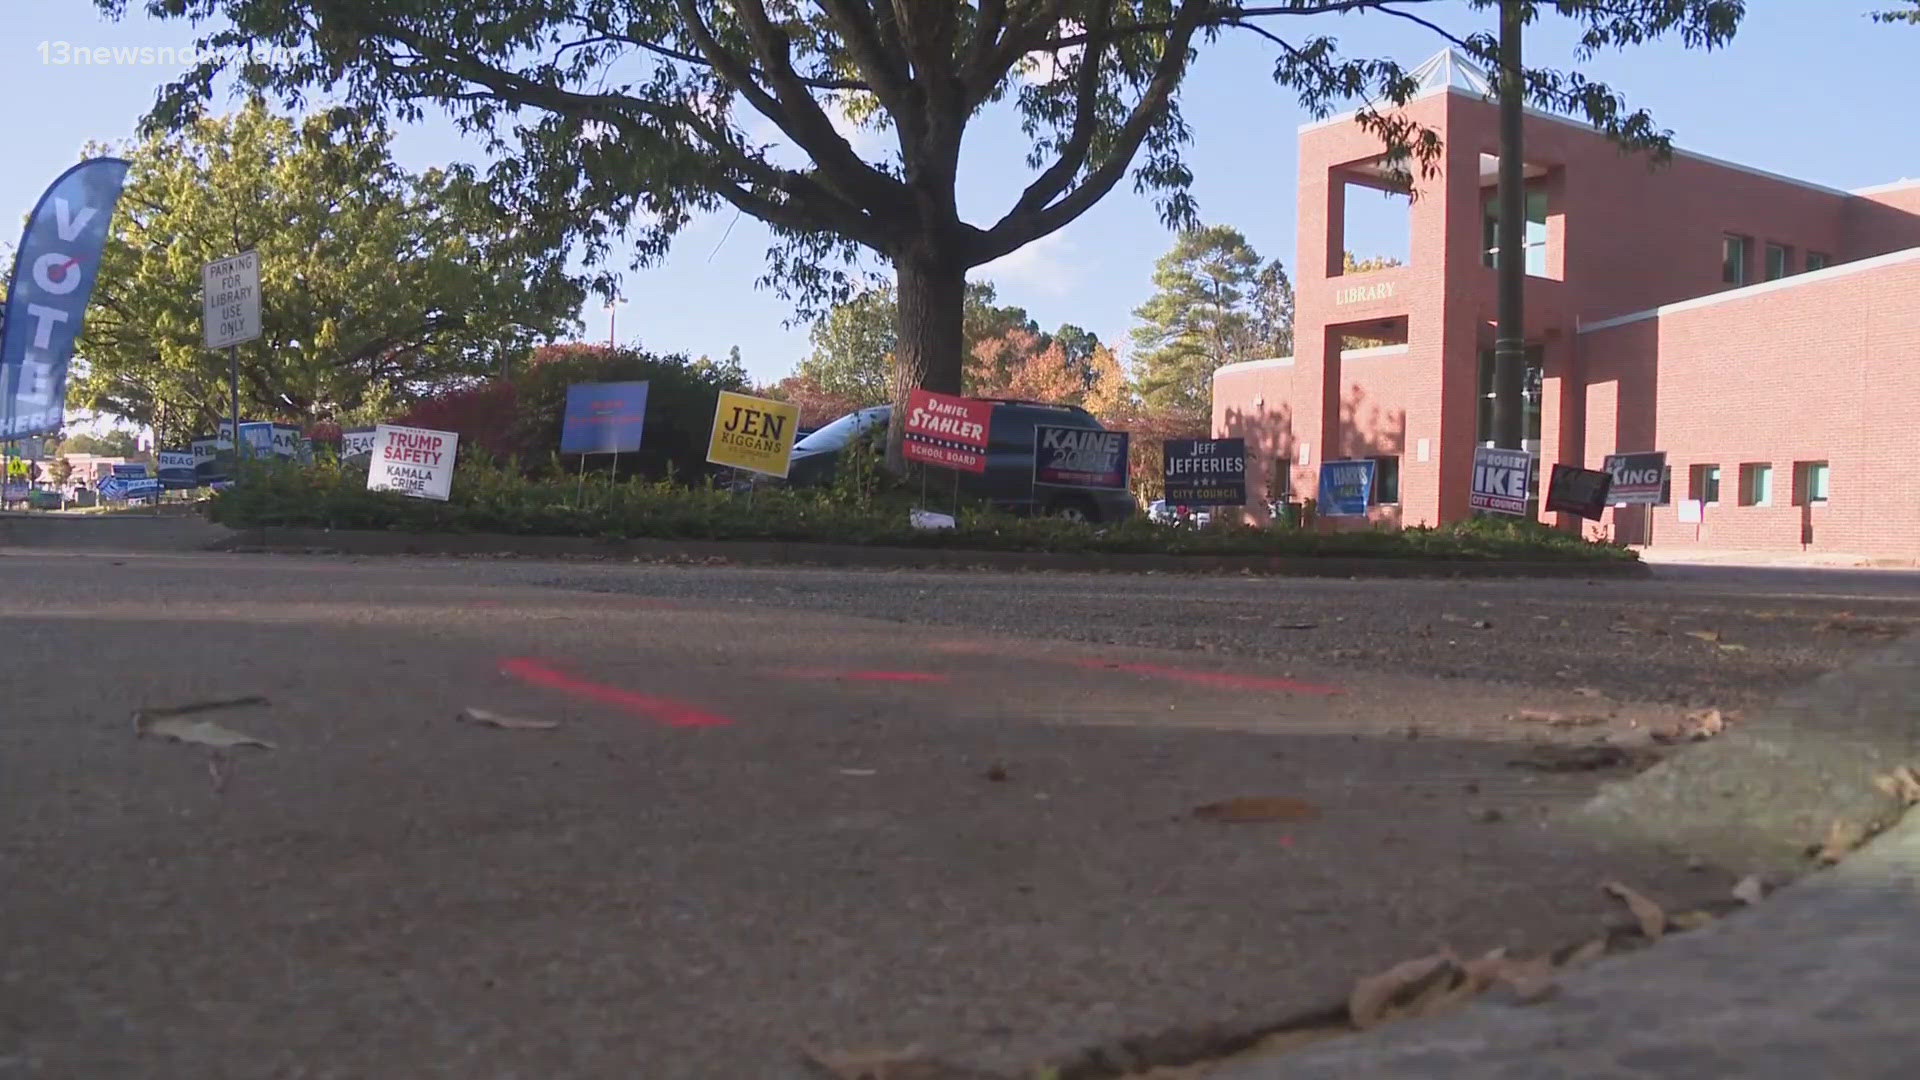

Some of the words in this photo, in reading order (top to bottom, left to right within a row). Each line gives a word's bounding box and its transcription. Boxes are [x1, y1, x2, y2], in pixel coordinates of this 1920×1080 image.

[210, 256, 252, 279] PARKING
[222, 274, 241, 289] FOR
[16, 197, 98, 406] VOTE
[211, 285, 252, 308] LIBRARY
[1336, 281, 1395, 305] LIBRARY
[222, 303, 242, 320] USE
[220, 318, 245, 335] ONLY
[928, 398, 968, 418] DANIEL
[724, 407, 786, 440] JEN
[909, 407, 983, 441] STAHLER
[388, 432, 442, 450] TRUMP
[721, 431, 782, 453] KIGGANS
[1042, 428, 1122, 453] KAINE
[1191, 441, 1217, 456] JEFF
[384, 445, 443, 466] SAFETY
[911, 445, 944, 460] SCHOOL
[947, 452, 976, 466] BOARD
[1487, 454, 1527, 468] ROBERT
[386, 466, 433, 481] KAMALA
[1166, 457, 1244, 476] JEFFERIES
[391, 477, 426, 491] CRIME
[1474, 466, 1526, 497] IKE
[1173, 488, 1193, 499] CITY
[1197, 488, 1239, 499] COUNCIL
[1472, 496, 1489, 509] CITY
[1490, 498, 1525, 511] COUNCIL
